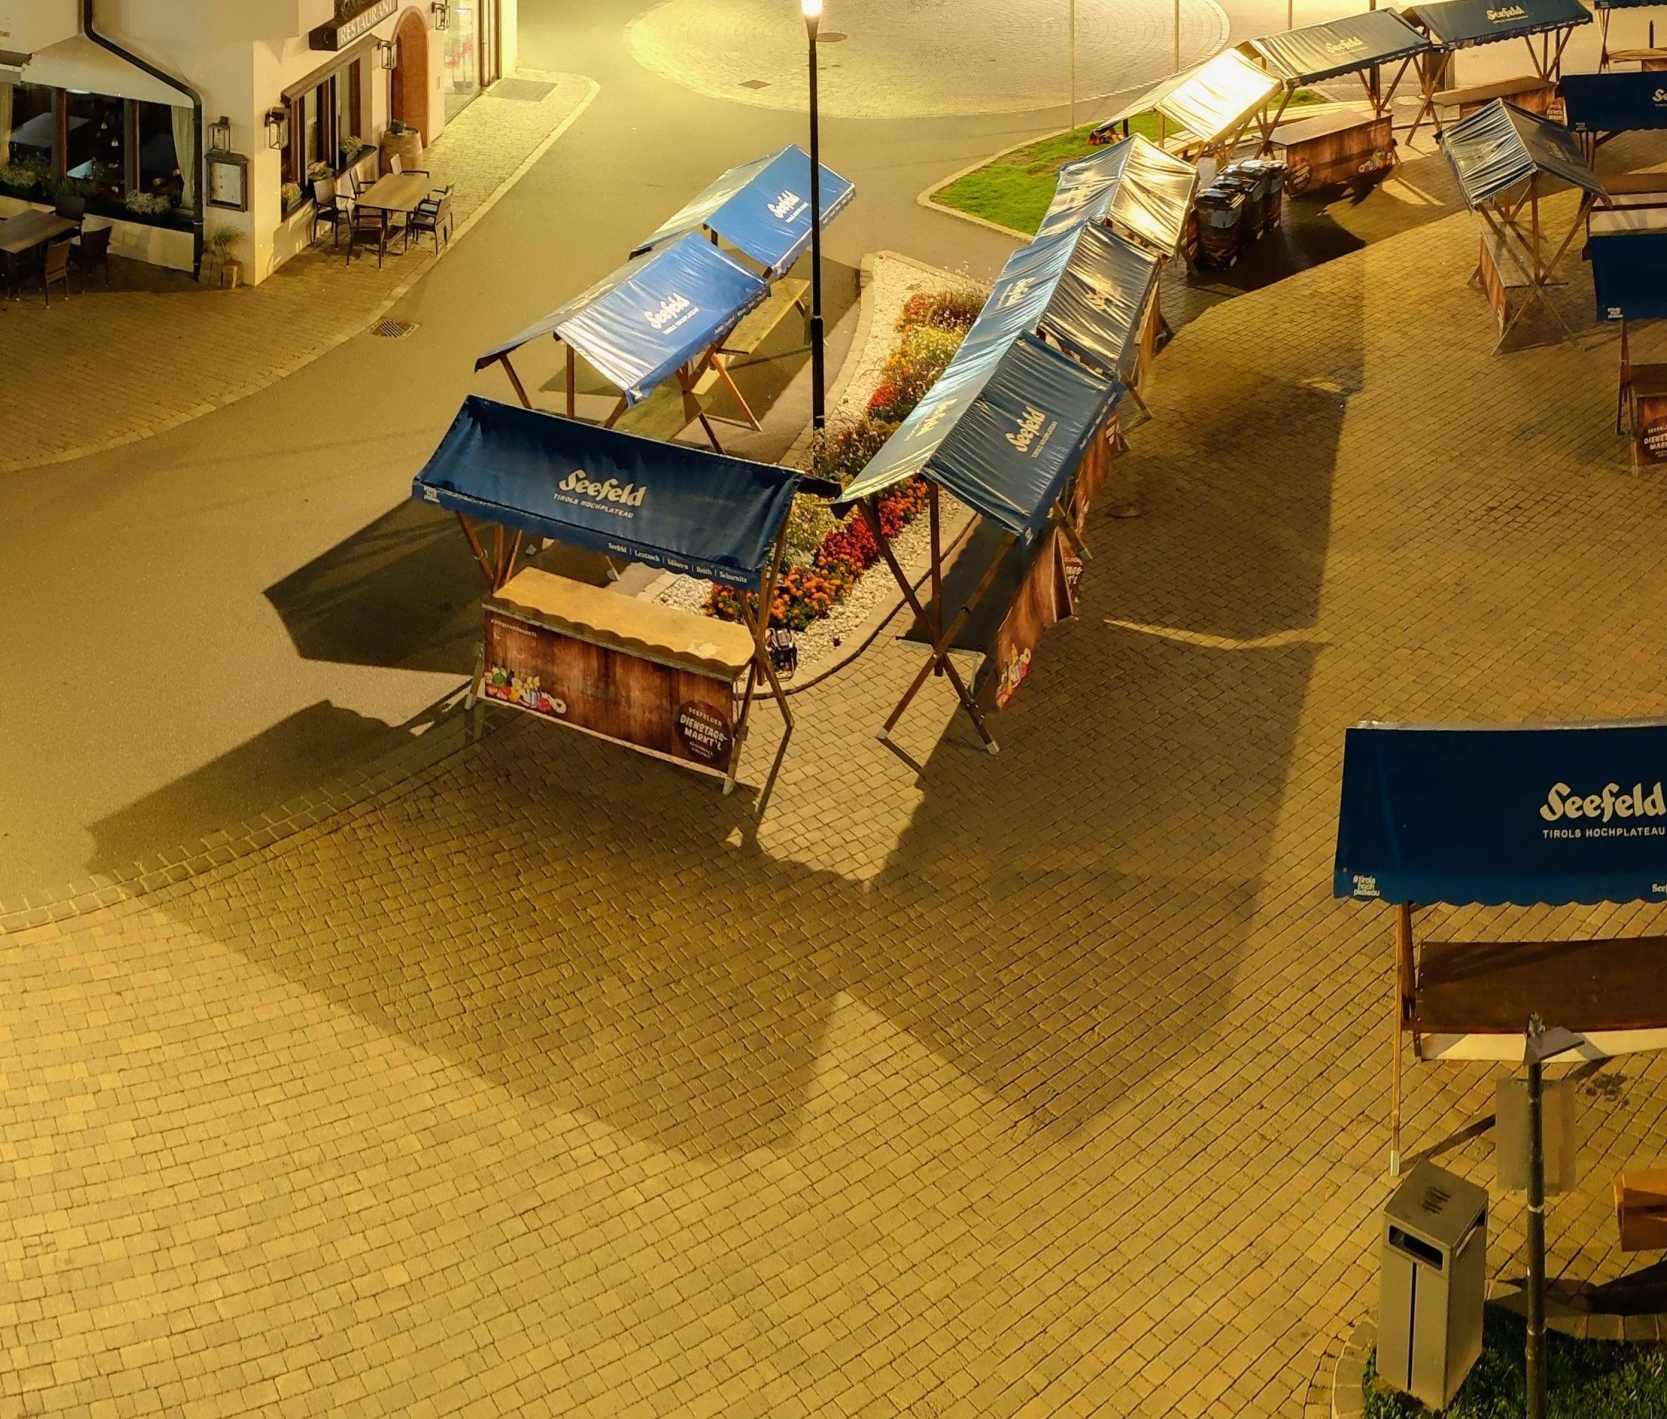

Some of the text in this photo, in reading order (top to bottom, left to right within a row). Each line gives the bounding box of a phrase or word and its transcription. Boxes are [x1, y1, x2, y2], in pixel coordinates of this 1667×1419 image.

[1487, 4, 1525, 21] Seefeld
[1005, 405, 1047, 454] Seefeld
[558, 469, 647, 507] Seefeld
[553, 493, 634, 519] TIROLS HOCHPLATEAU
[1540, 781, 1666, 823] Seefeld
[1543, 827, 1666, 839] TIROLS HOCHPLATEAU
